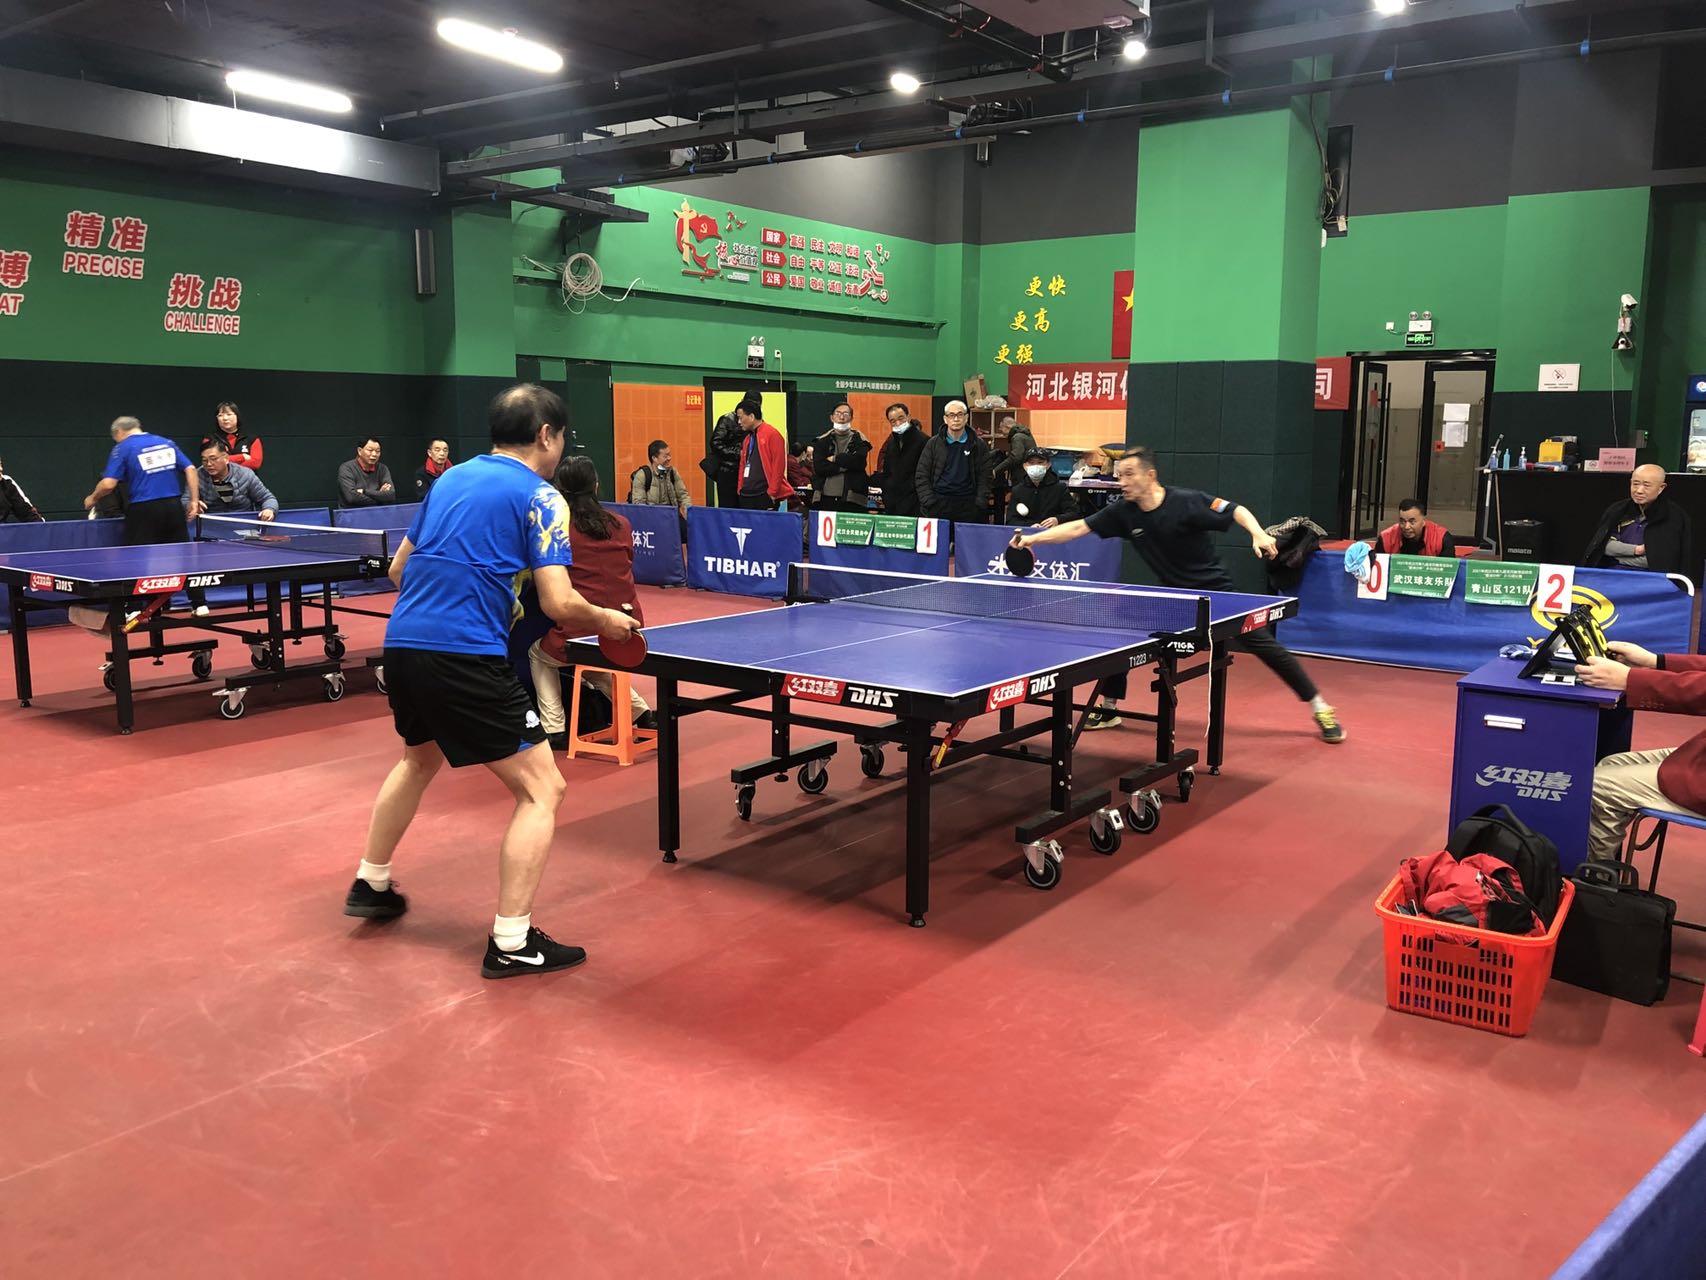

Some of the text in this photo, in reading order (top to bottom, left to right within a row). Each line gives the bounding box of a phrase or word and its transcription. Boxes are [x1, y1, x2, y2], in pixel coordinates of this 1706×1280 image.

[65, 211, 148, 252] 精准
[63, 253, 144, 279] PRECISE
[766, 252, 781, 264] 社会
[766, 273, 781, 285] 公民
[1025, 274, 1066, 297] 更快
[169, 274, 241, 310] 挑战
[164, 312, 240, 335] CHALLENGE
[1009, 308, 1050, 333] 更高
[993, 344, 1034, 365] 更强
[823, 516, 833, 541] 0
[923, 521, 932, 548] 1
[704, 556, 777, 578] TIBHAR
[1366, 560, 1382, 593] 0
[55, 579, 73, 592] DHS
[188, 575, 224, 588] DHS
[1393, 574, 1454, 587] 武汉球友乐队
[1471, 583, 1531, 595] 青山区121队
[1544, 574, 1566, 609] 2
[1269, 606, 1286, 621] DHS
[1129, 653, 1147, 667] T1223
[787, 677, 839, 697] 红双喜
[1030, 672, 1060, 695] DHS
[848, 686, 899, 708] DHS
[990, 680, 1025, 710] 红双喜
[1475, 765, 1573, 791] 红双喜
[1515, 785, 1568, 802] DHS
